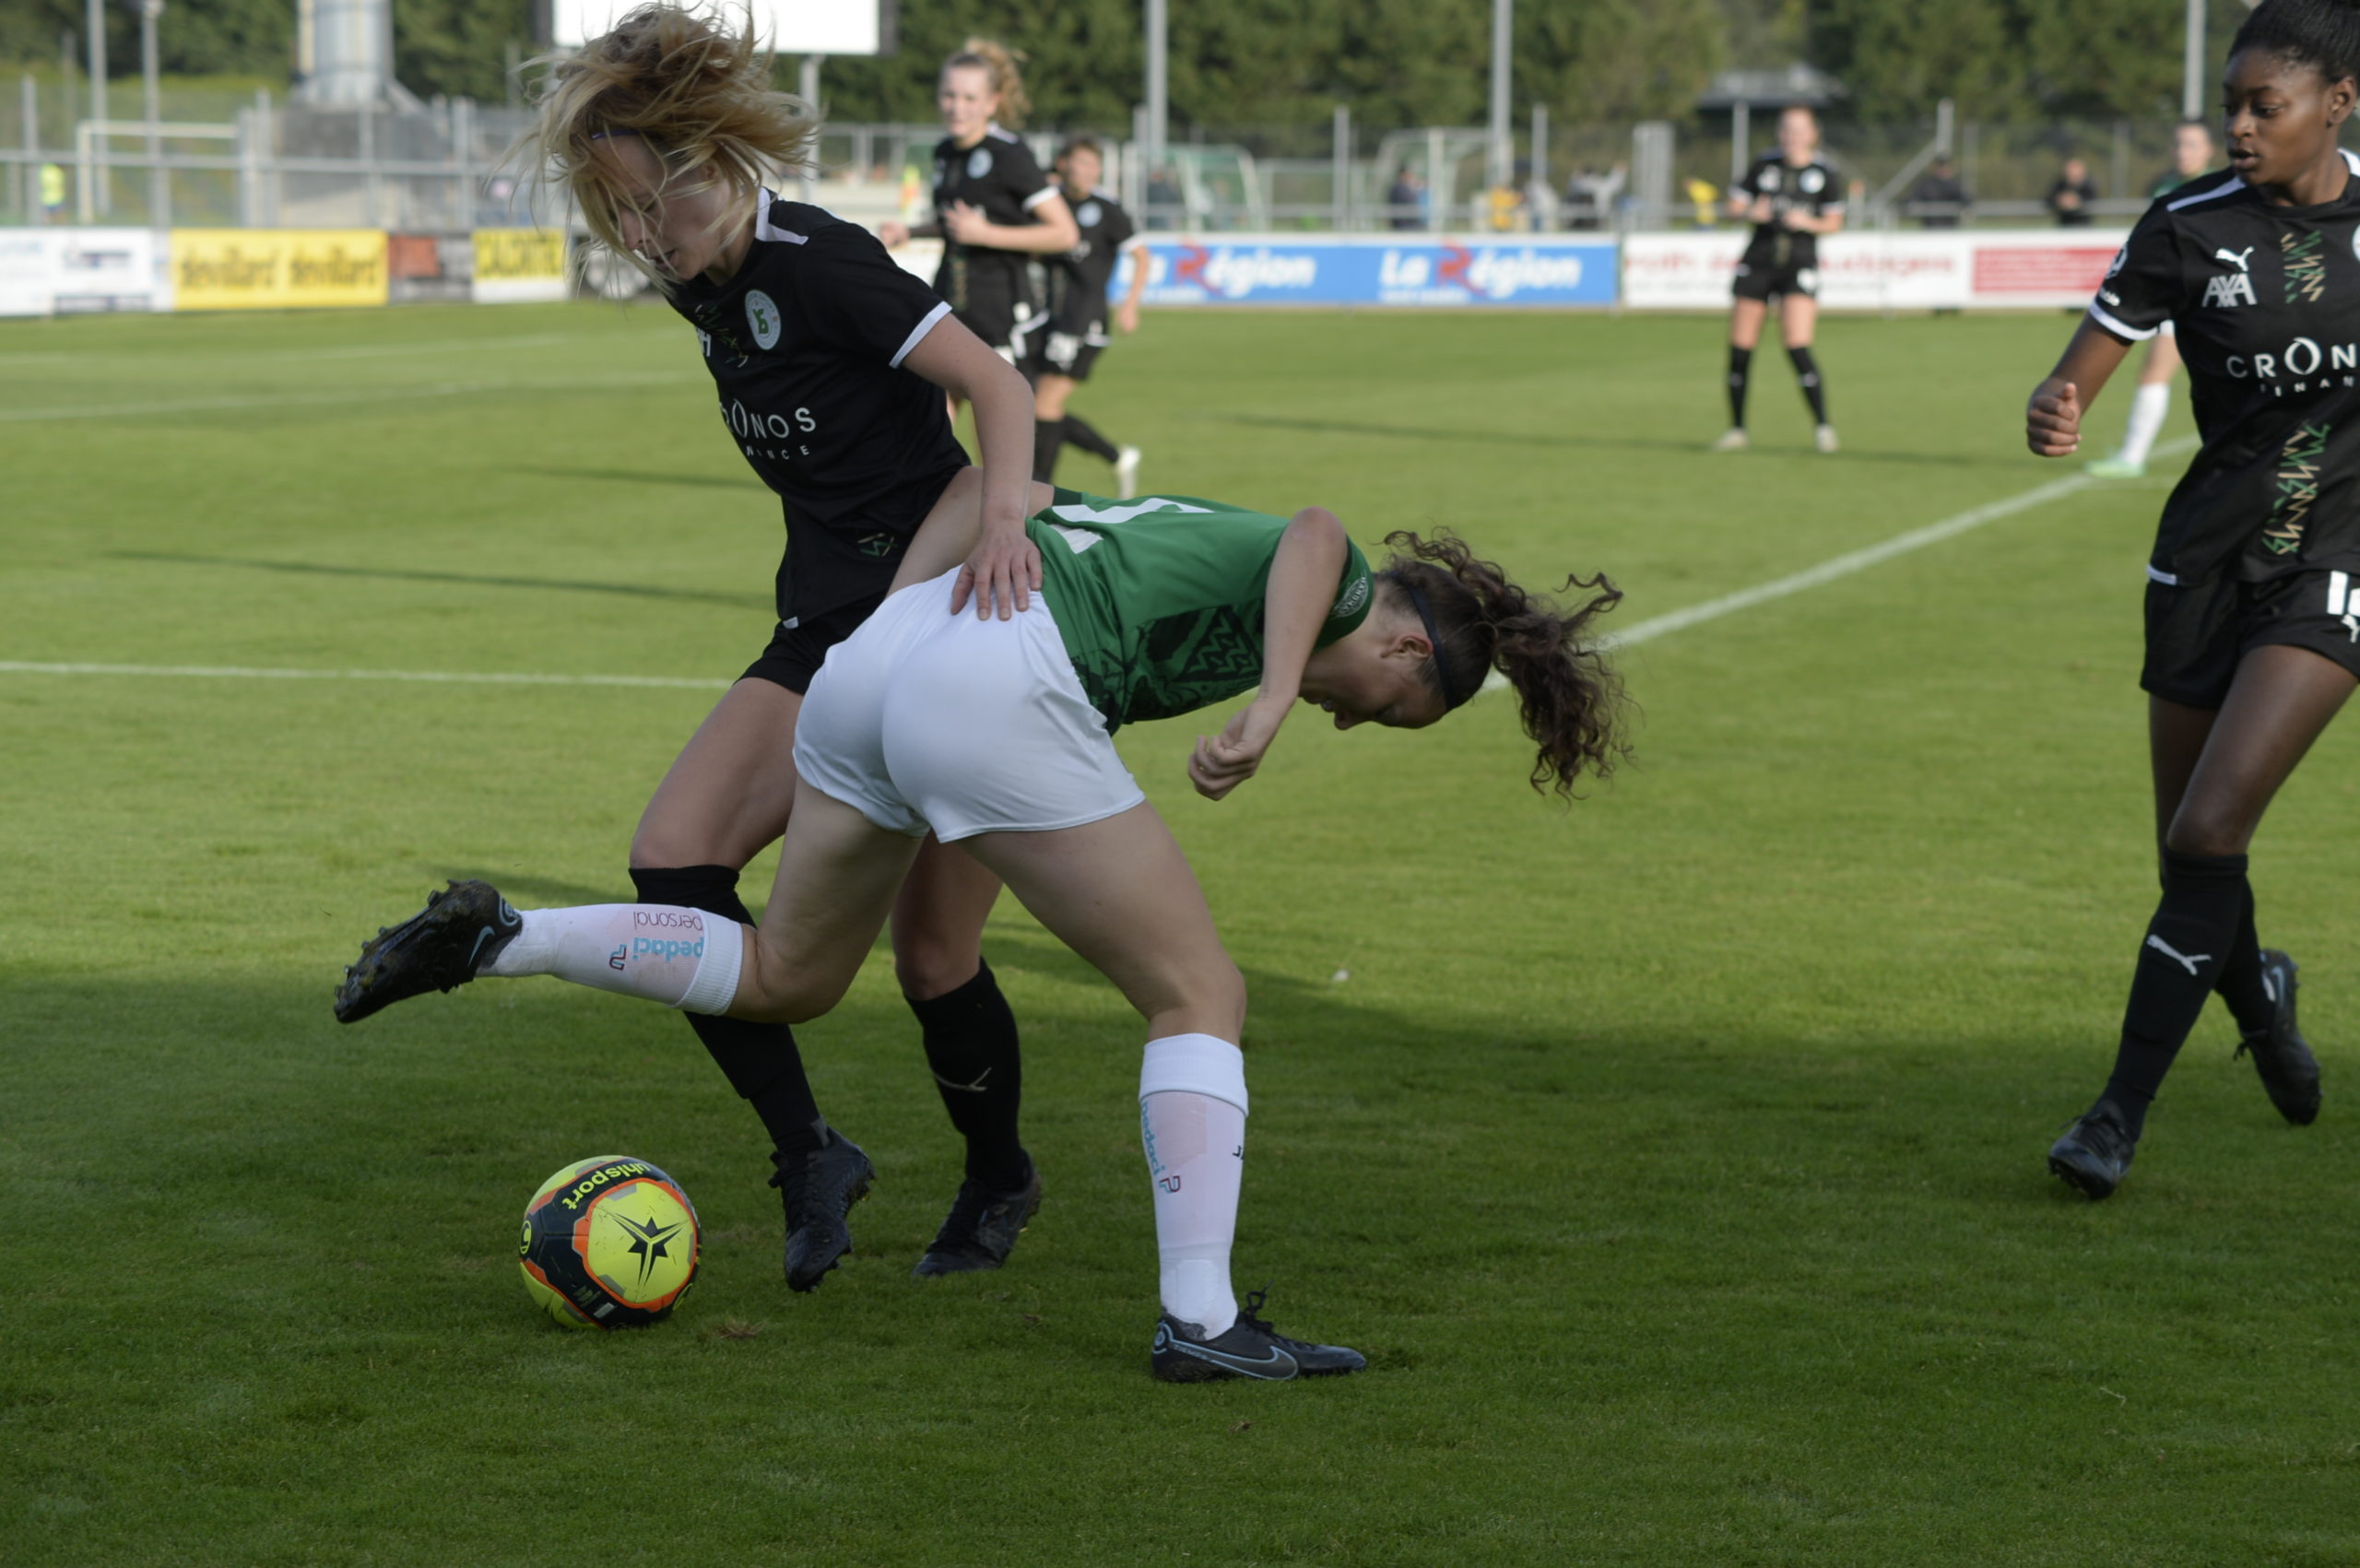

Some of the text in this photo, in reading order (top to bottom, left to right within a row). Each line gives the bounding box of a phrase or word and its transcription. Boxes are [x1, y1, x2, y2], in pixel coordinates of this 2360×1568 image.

[1378, 234, 1582, 300] La Région
[2201, 272, 2258, 309] AXA
[2225, 336, 2357, 379] CRON
[632, 911, 704, 931] personal
[561, 1162, 651, 1210] uhlsport
